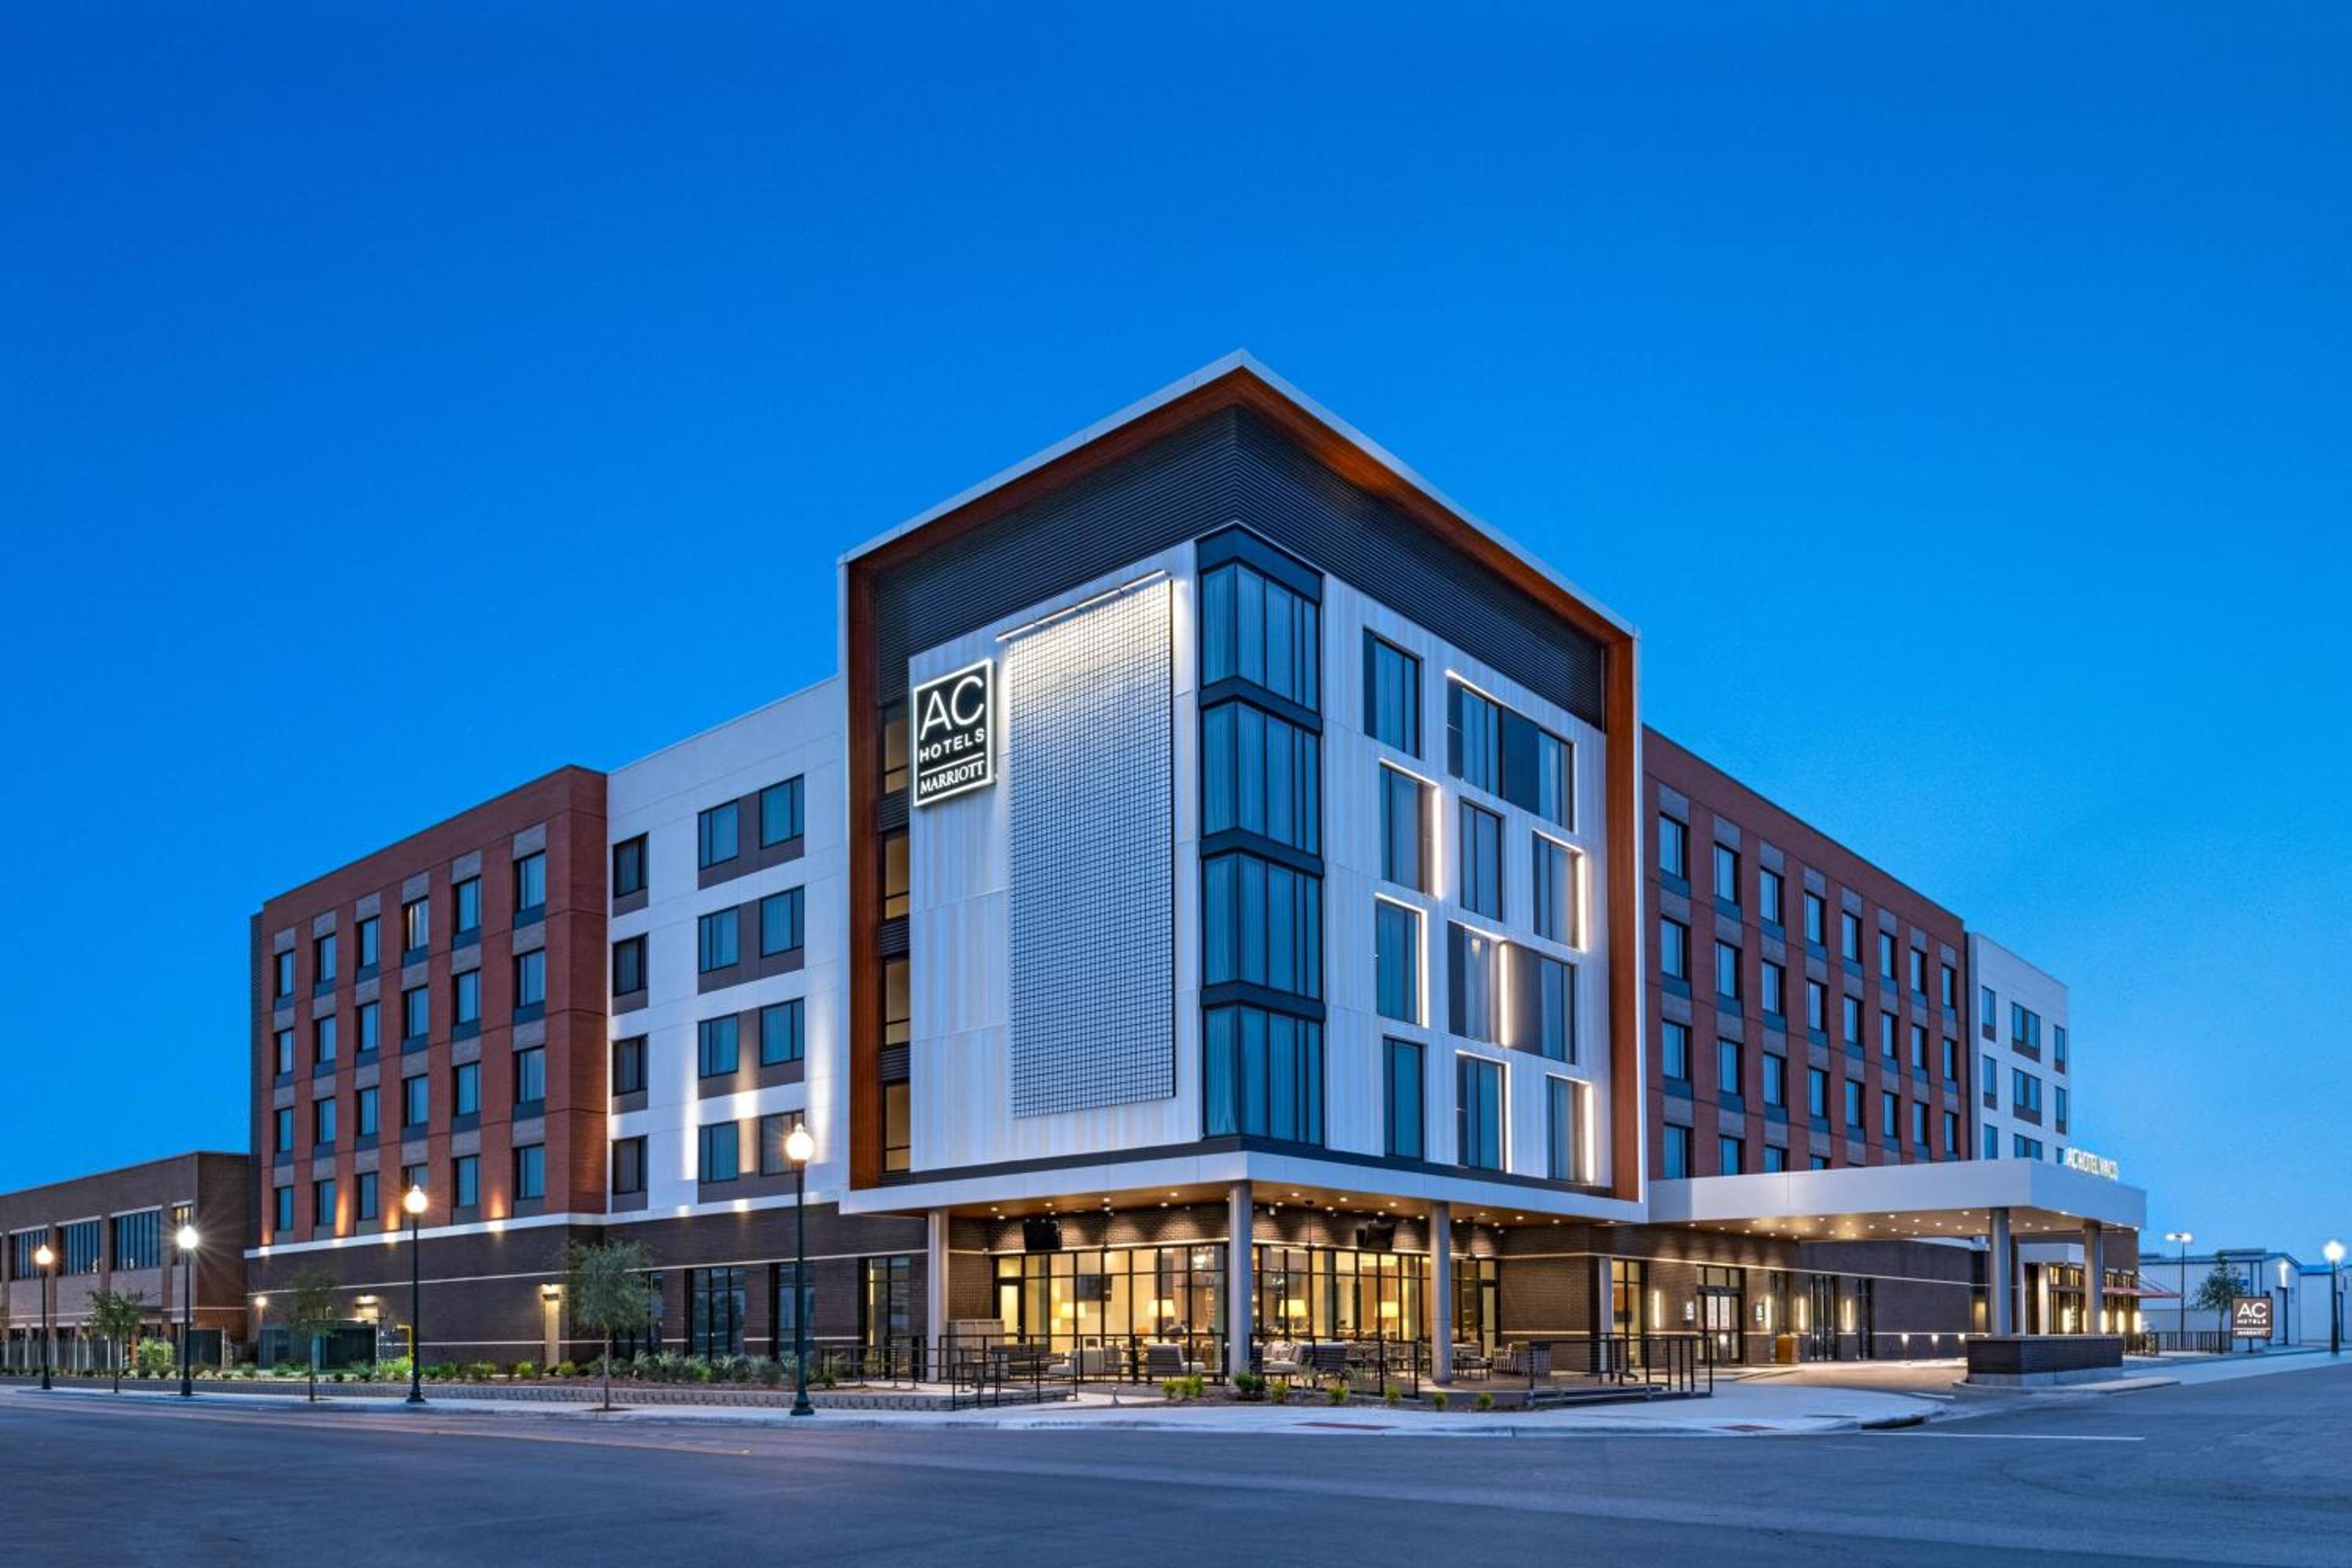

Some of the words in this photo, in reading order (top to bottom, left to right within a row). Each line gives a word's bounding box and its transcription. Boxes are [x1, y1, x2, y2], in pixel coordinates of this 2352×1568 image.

[920, 676, 984, 740] AC
[920, 728, 985, 763] HOTELS
[920, 759, 985, 794] MARRIOTT
[2237, 1302, 2267, 1318] AC
